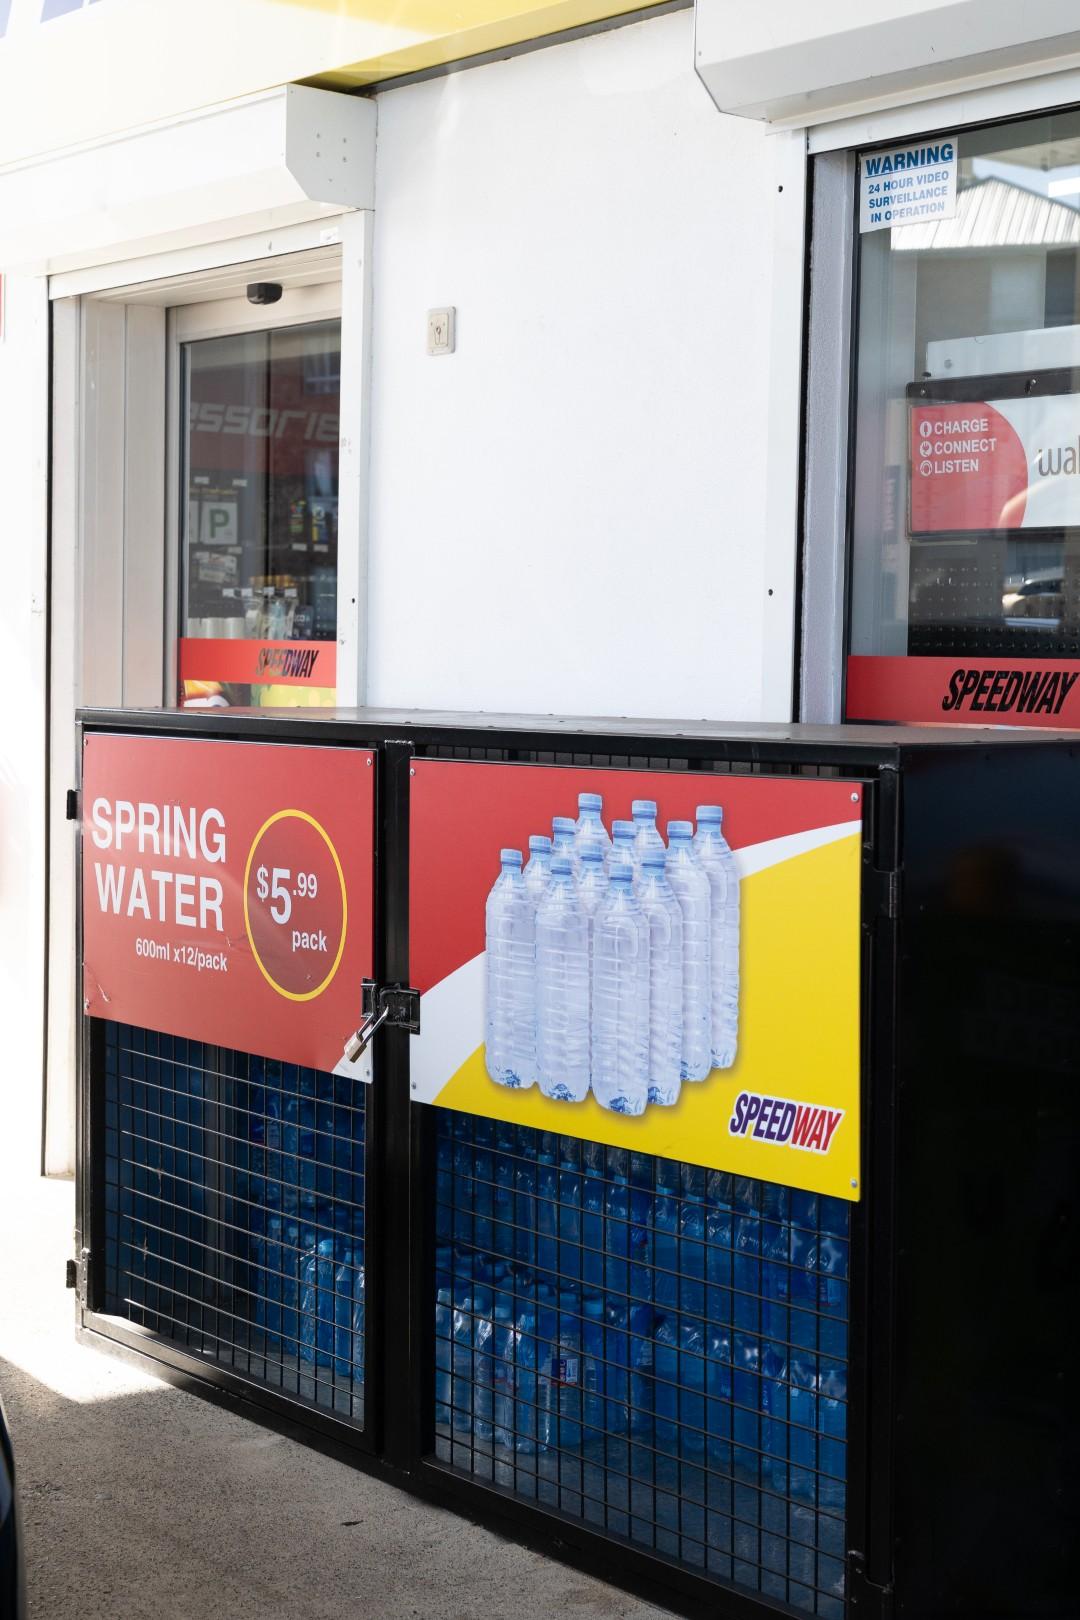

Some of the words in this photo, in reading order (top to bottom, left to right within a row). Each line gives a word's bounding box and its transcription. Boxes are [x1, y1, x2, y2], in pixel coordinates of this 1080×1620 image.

[865, 144, 953, 176] WARNING
[868, 184, 881, 195] 24
[883, 177, 914, 192] HOUR
[916, 171, 949, 185] VIDEO
[869, 186, 948, 208] SURVEILLANCE
[870, 213, 882, 223] IN
[884, 201, 945, 221] OPERATION
[934, 418, 989, 435] CHARGE
[934, 437, 997, 455] CONNECT
[934, 459, 979, 474] LISTEN
[209, 508, 229, 539] P
[256, 648, 319, 678] SPEEDWAY
[942, 669, 1080, 714] SPEEDWAY
[91, 797, 226, 863] SPRING
[94, 862, 225, 932] WATER
[256, 863, 318, 925] $5.99
[135, 937, 170, 961] 600ml
[173, 946, 228, 972] x12/pack
[292, 929, 327, 952] pack
[729, 1092, 842, 1152] SPEEDWAY
